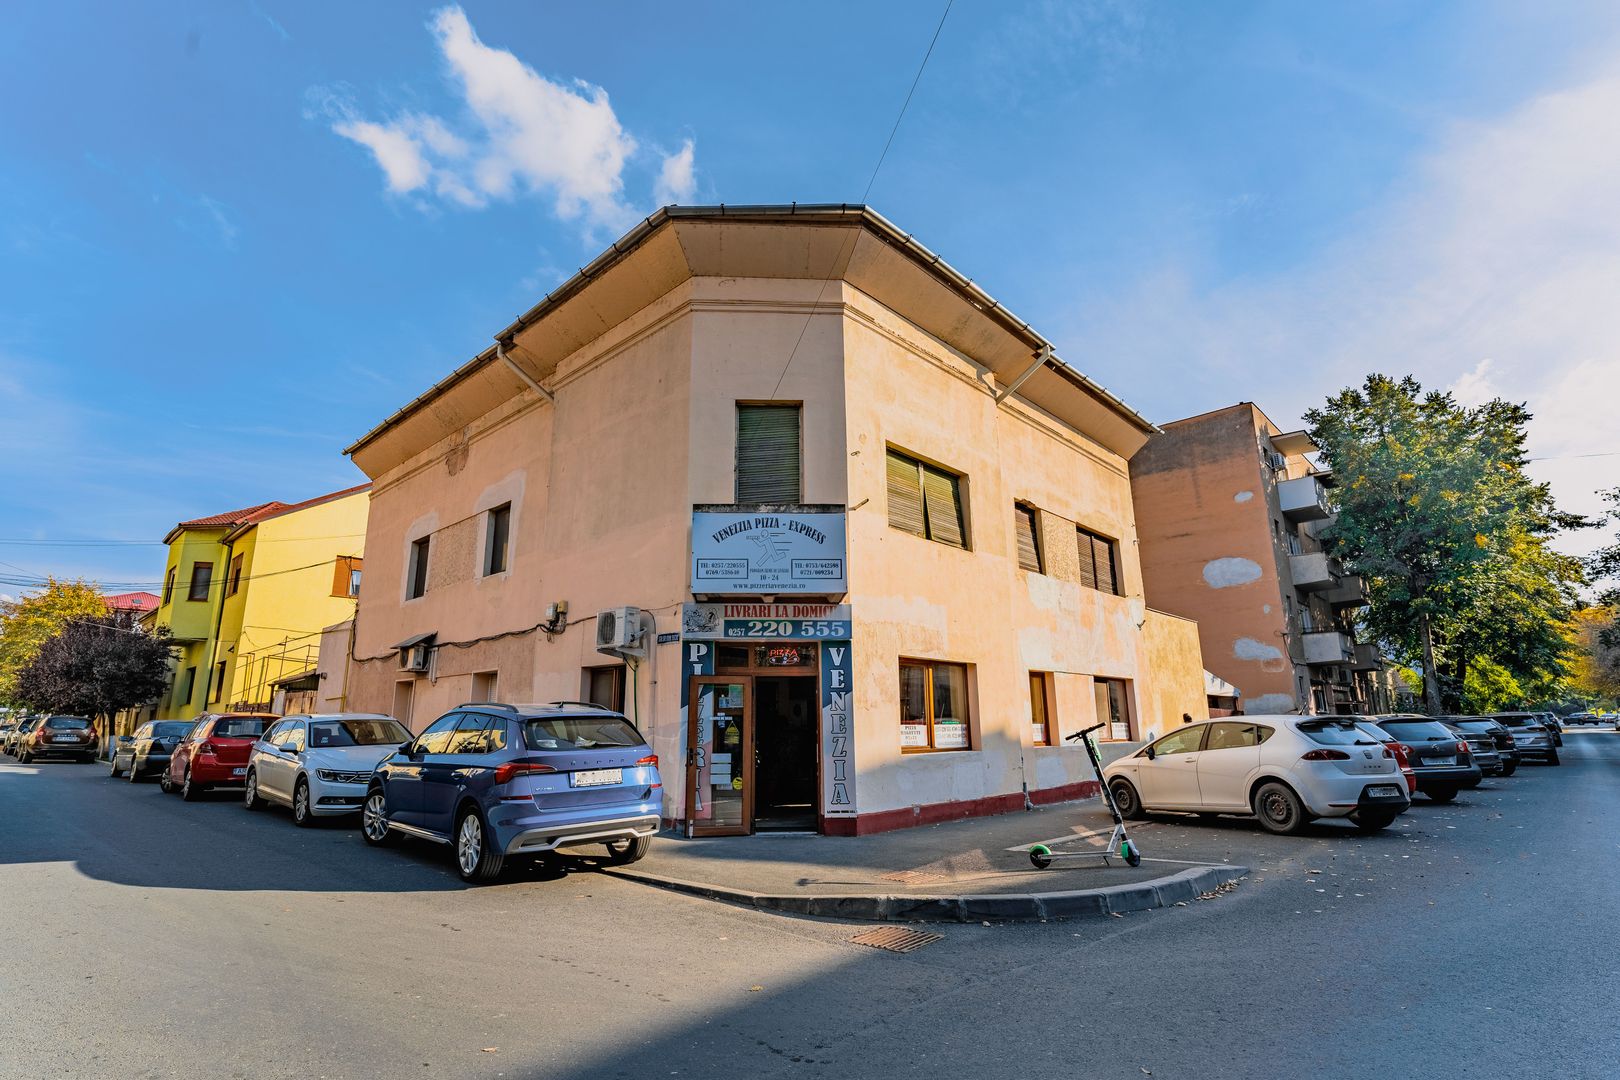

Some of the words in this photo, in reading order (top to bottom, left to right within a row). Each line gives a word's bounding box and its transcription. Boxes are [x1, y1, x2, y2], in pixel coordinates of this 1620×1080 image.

[755, 517, 780, 529] PIZZA
[788, 519, 826, 545] EXPRESS
[724, 605, 771, 618] LIVRARI
[775, 605, 788, 618] LA
[728, 627, 746, 637] 0257
[747, 621, 793, 637] 220
[800, 621, 845, 637] 555
[769, 648, 799, 657] PIZZA
[828, 647, 850, 805] VENEZIA
